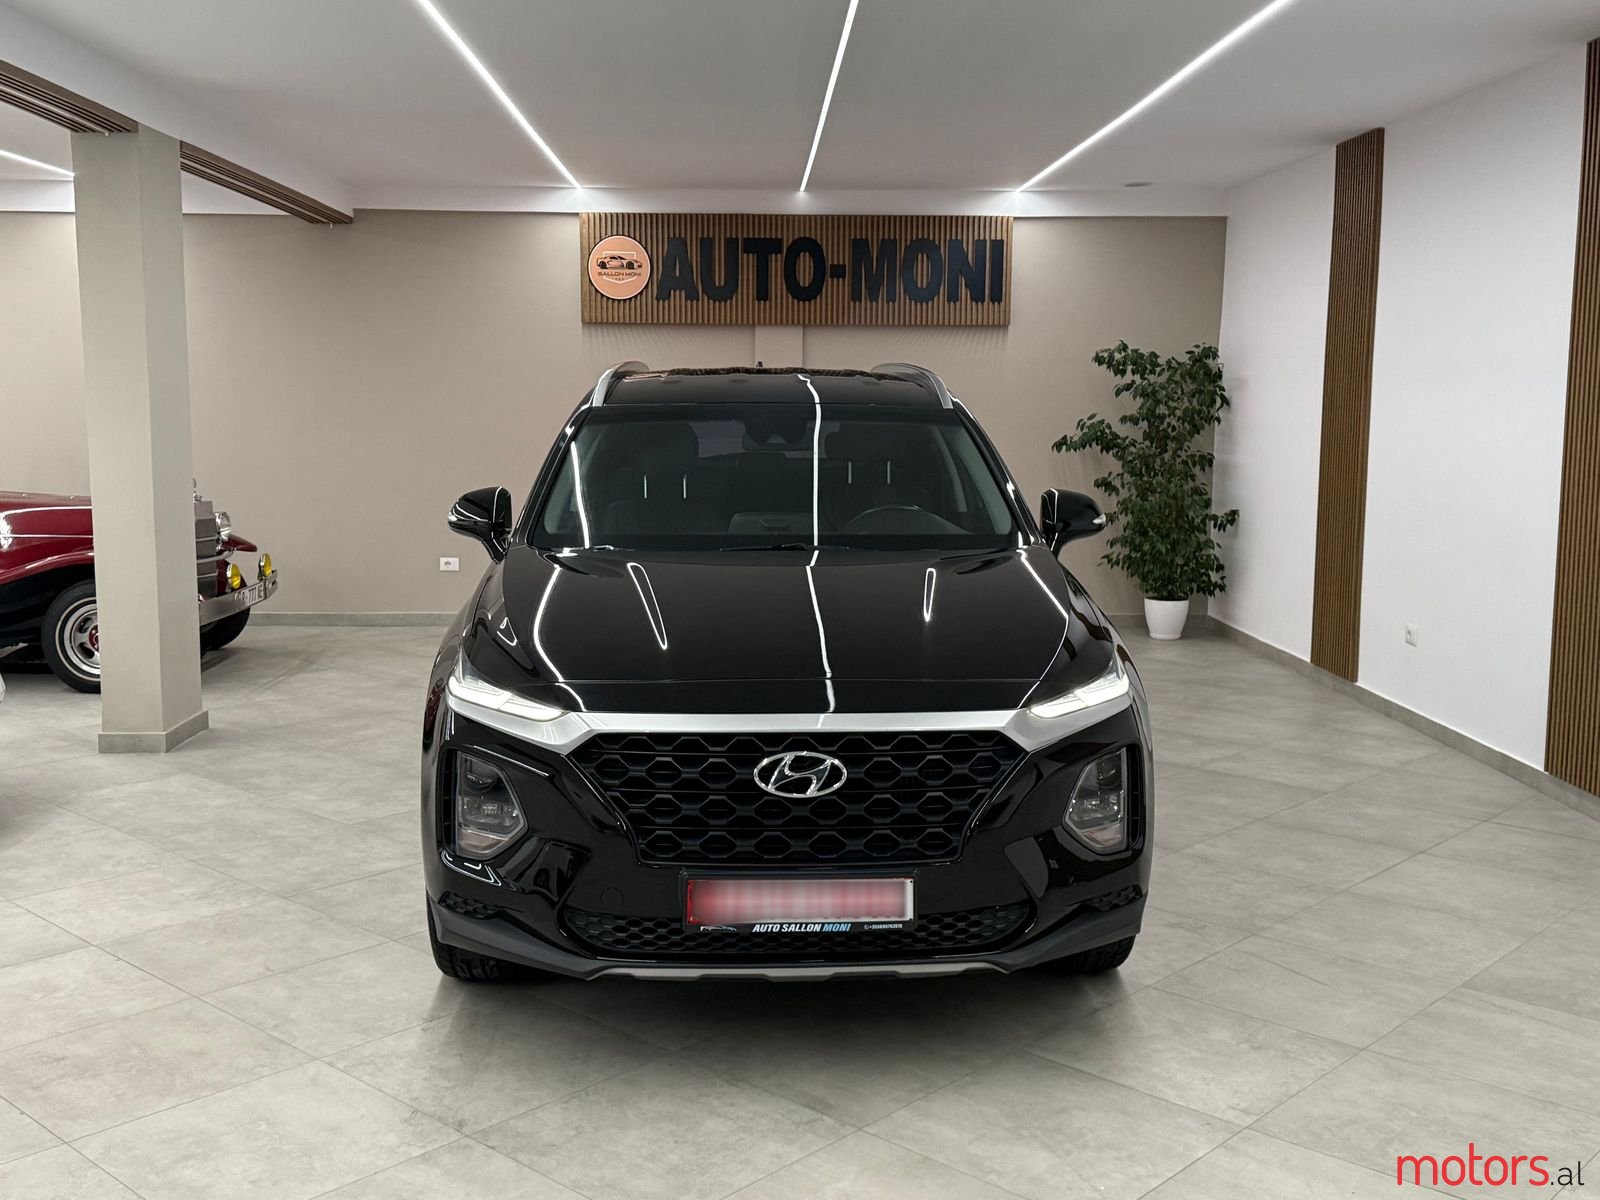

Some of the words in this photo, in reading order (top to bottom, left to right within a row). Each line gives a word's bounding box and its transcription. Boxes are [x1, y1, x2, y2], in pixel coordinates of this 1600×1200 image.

[656, 236, 1005, 304] AUTO-MONI
[752, 923, 780, 933] AUTO
[781, 923, 822, 932] SALLON
[822, 922, 852, 932] MONI
